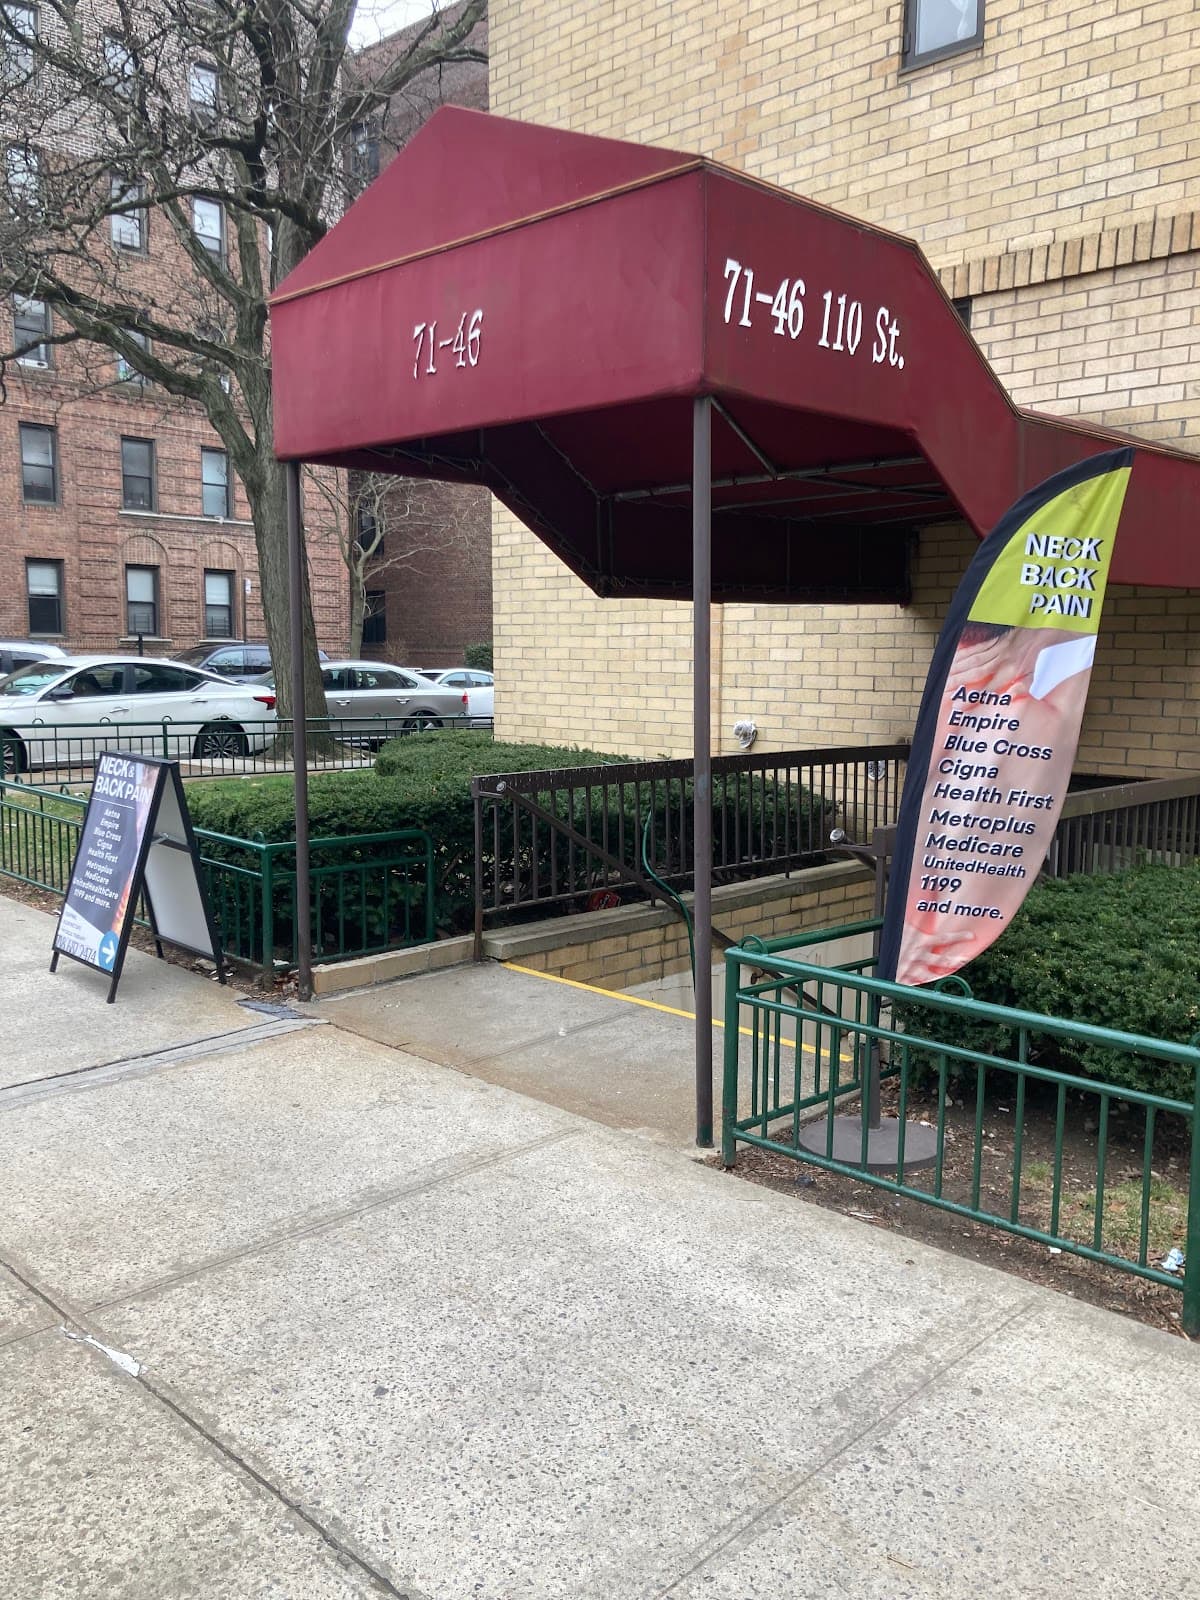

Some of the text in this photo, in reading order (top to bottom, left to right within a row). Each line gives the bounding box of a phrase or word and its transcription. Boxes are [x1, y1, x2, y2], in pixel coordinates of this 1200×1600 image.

[724, 257, 905, 370] 71-46 110 St.
[412, 308, 484, 380] 71-46
[1024, 532, 1104, 562] NECK
[1020, 562, 1098, 591] BACK
[1029, 592, 1093, 618] PAIN
[951, 686, 1012, 706] Aetna
[948, 710, 1020, 732] Empire
[944, 735, 1053, 760] Blue Cross
[99, 756, 135, 778] NECK &
[939, 758, 999, 780] Cigna
[95, 775, 153, 804] BACK PAIN
[933, 782, 1054, 810] Health First
[100, 818, 120, 830] Empire
[104, 808, 121, 819] Aetna
[928, 808, 1037, 835] Metroplus
[925, 833, 1024, 858] Medicare
[923, 855, 1026, 878] UnitedHealth
[921, 874, 962, 893] 1199
[917, 900, 1004, 920] and more.
